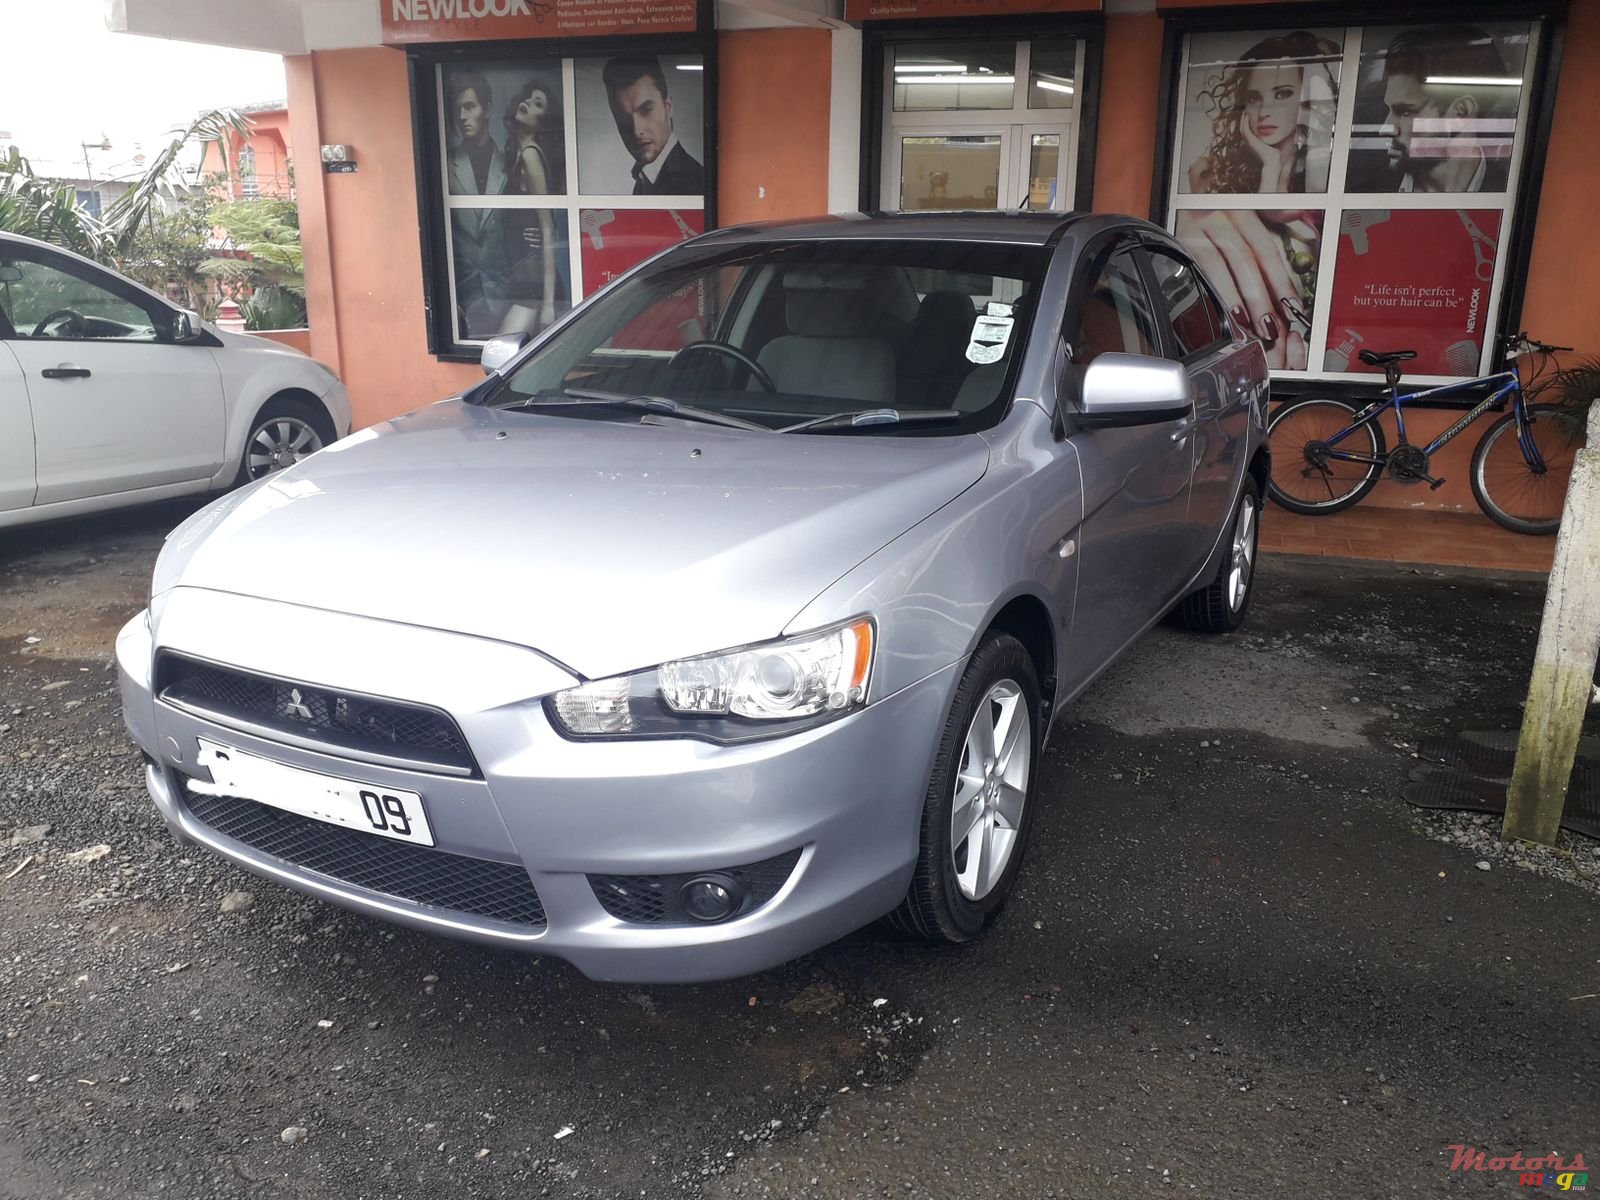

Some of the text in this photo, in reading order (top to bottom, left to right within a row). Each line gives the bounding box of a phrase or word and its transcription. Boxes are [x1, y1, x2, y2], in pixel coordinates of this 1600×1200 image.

[393, 0, 531, 21] NEWLOOK
[1353, 296, 1371, 306] but
[1373, 298, 1397, 309] your
[1400, 296, 1422, 307] hair
[1423, 299, 1442, 308] can
[1418, 286, 1456, 298] perfect
[1466, 288, 1481, 334] NEWLOOK
[359, 790, 412, 836] 09
